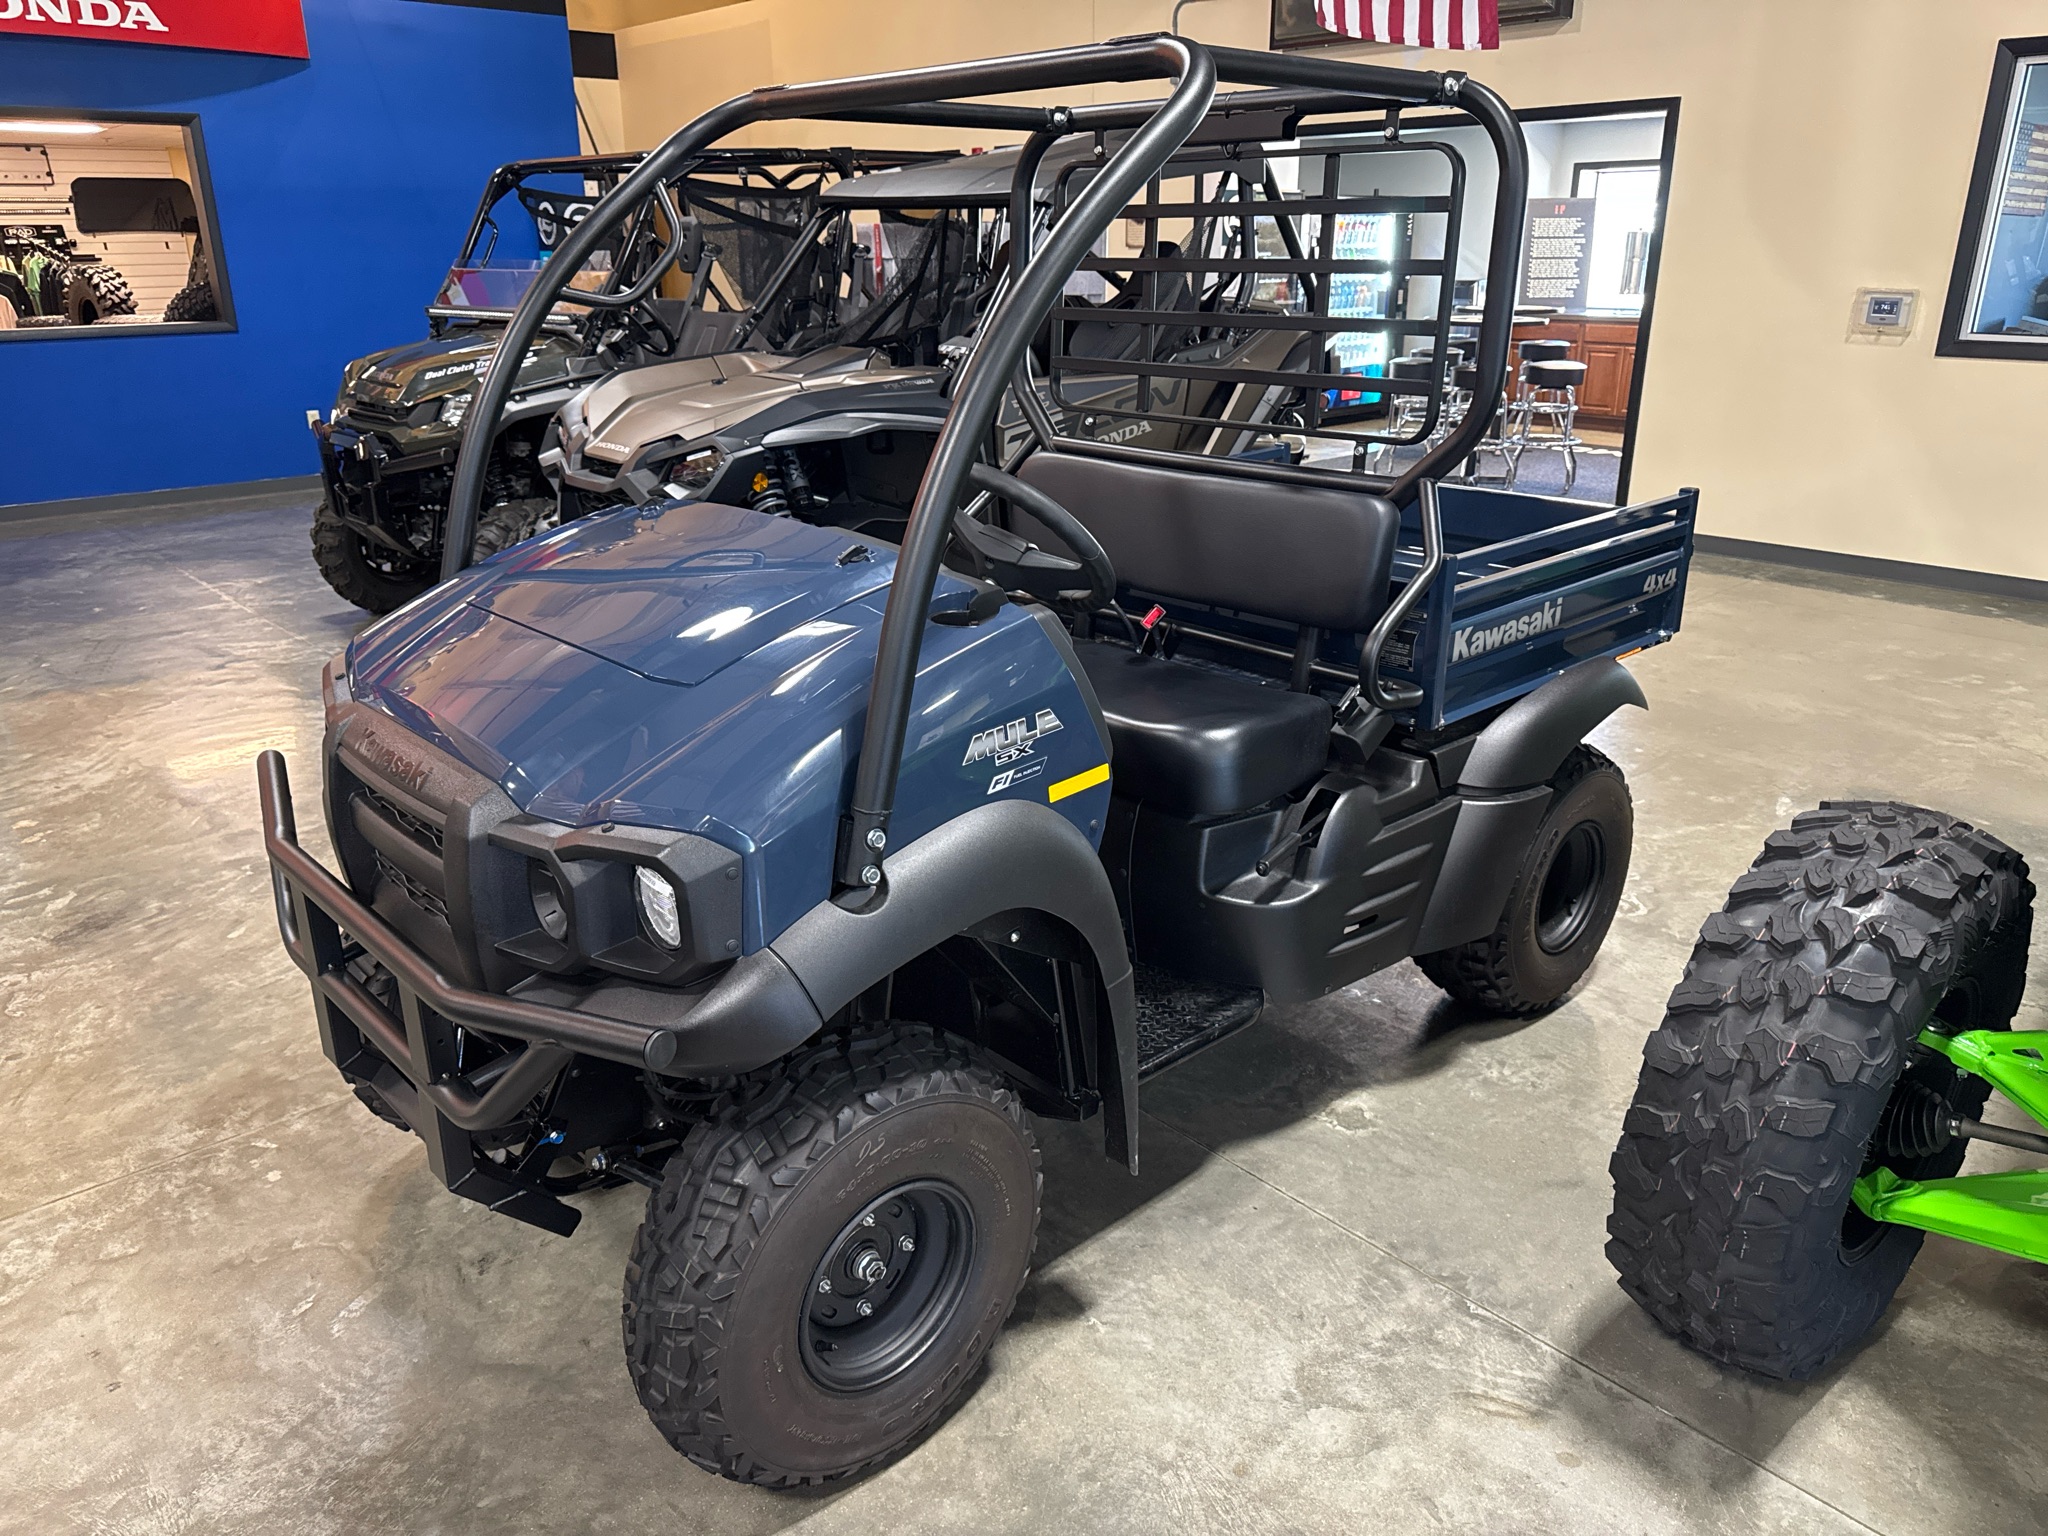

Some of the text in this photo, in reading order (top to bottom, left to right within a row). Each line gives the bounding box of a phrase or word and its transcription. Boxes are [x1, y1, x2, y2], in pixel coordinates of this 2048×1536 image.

[424, 360, 491, 380] Dual Clutch Tra
[595, 441, 631, 454] HONDA
[1643, 567, 1678, 594] 4x4
[1451, 597, 1564, 663] Kawasaki
[962, 708, 1064, 766] MULE
[354, 727, 434, 792] Kawasaki
[995, 742, 1034, 766] SX
[990, 770, 1014, 792] FI
